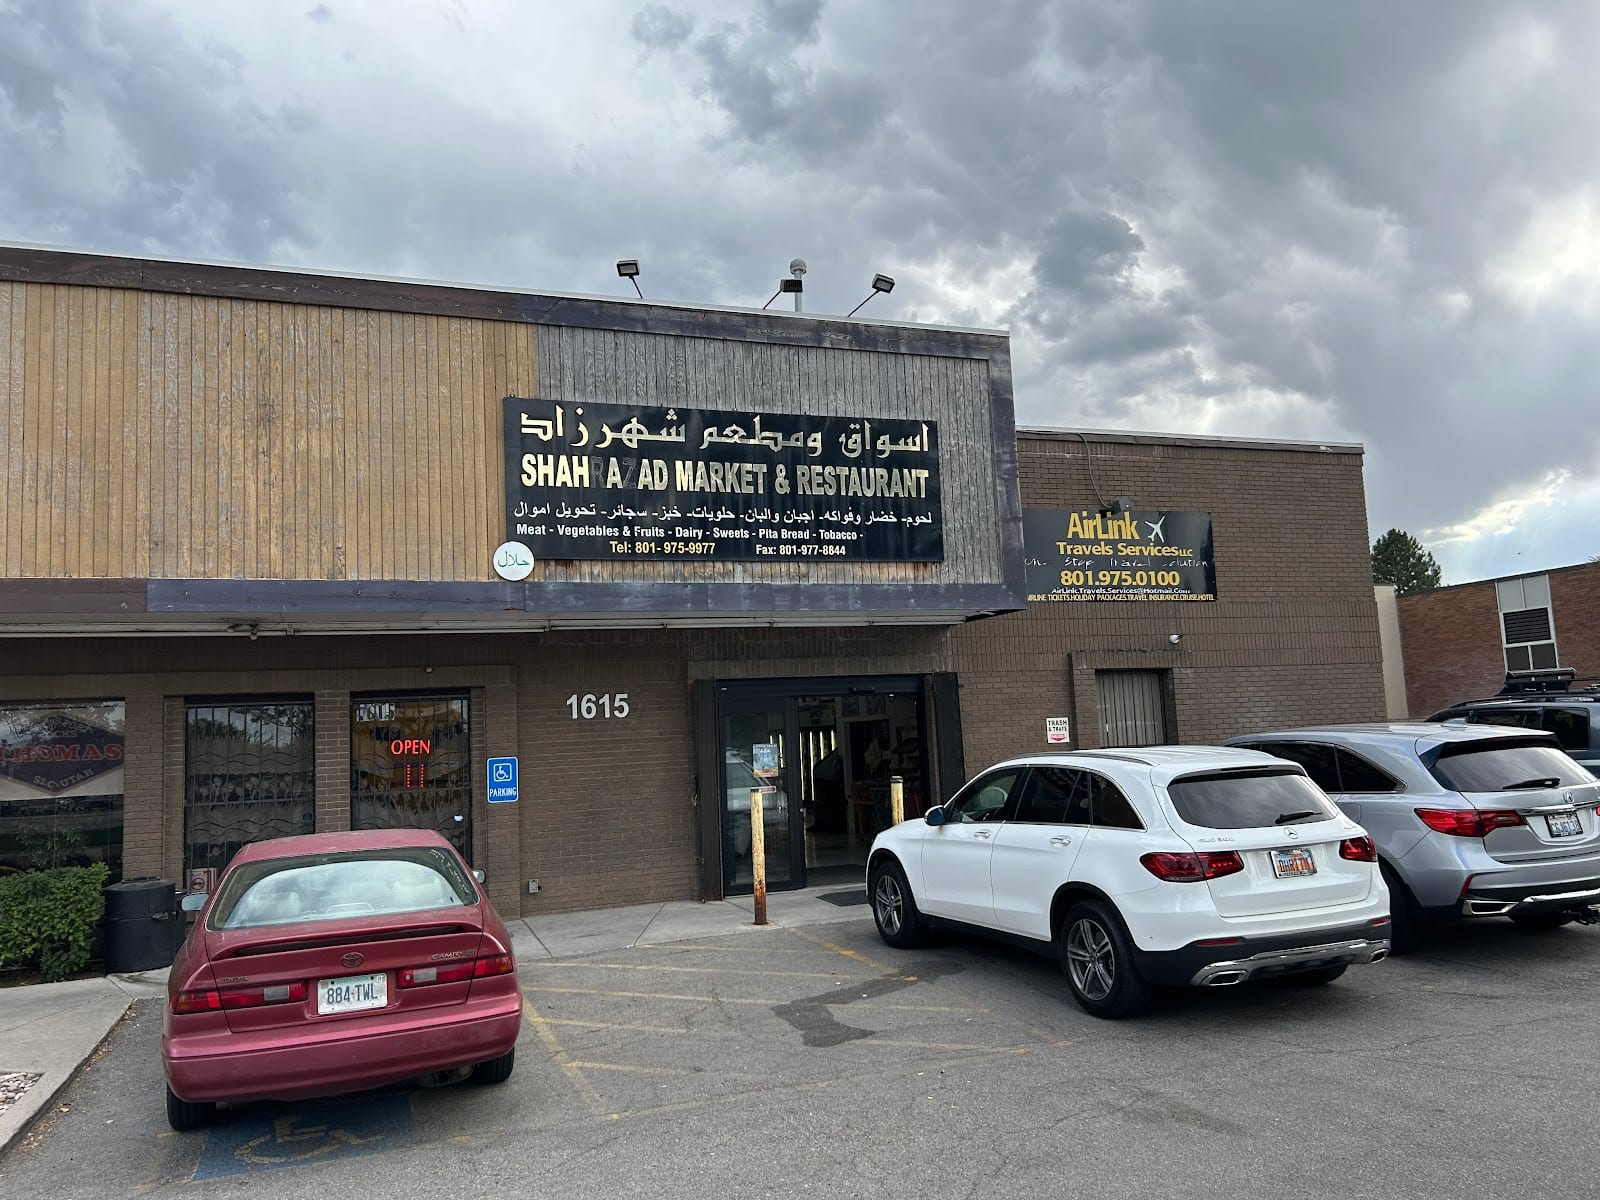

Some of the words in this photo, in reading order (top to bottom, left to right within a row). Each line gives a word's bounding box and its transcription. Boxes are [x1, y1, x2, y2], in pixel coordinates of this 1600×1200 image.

[699, 414, 823, 457] ومطعم
[838, 420, 930, 459] اسواق
[675, 460, 768, 495] MARKET
[774, 463, 791, 495] &
[796, 464, 929, 499] RESTAURANT
[516, 523, 546, 536] Meat
[557, 524, 620, 539] Vegetables
[622, 525, 632, 537] &
[634, 525, 665, 538] Fruits
[675, 526, 703, 542] Dairy
[713, 528, 750, 540] Sweets
[759, 529, 779, 540] Pita
[780, 529, 810, 540] Bread
[818, 529, 858, 541] Tobacco
[1066, 510, 1141, 541] AirLink
[609, 541, 632, 554] Tel:
[663, 541, 716, 555] 975-9977
[755, 545, 778, 556] Fax:
[779, 545, 847, 557] 801-977-8844
[1056, 541, 1114, 556] Travels
[497, 550, 531, 568] حلال
[1060, 570, 1181, 587] 801.975.0100
[566, 693, 630, 719] 1615
[0, 743, 123, 764] THOMAS
[390, 739, 431, 755] OPEN
[489, 786, 517, 798] PARKING
